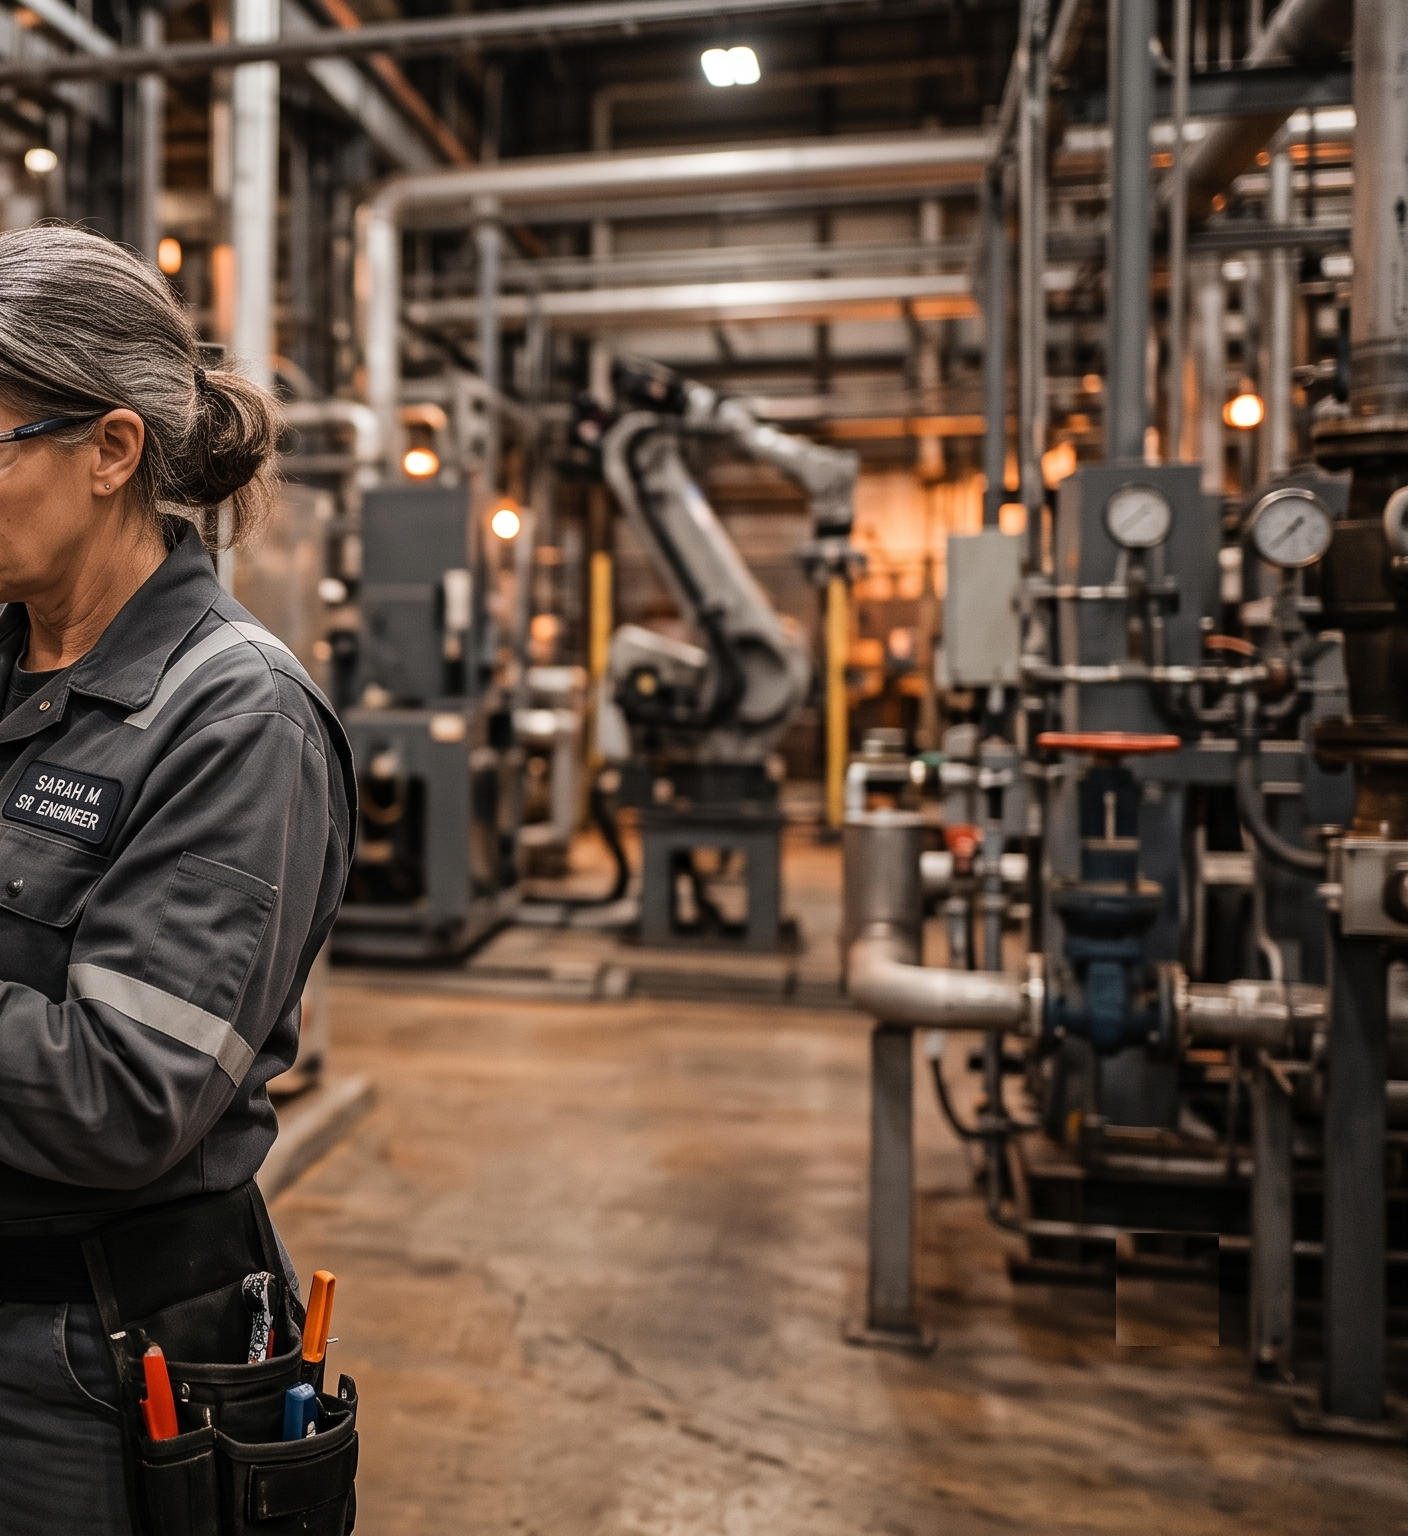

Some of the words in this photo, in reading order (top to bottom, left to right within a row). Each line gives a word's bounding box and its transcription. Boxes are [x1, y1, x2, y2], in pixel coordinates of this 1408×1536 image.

[35, 775, 85, 801] SARAH
[85, 787, 103, 806] M.
[15, 793, 34, 811] SR.
[36, 800, 99, 830] ENGINEER
